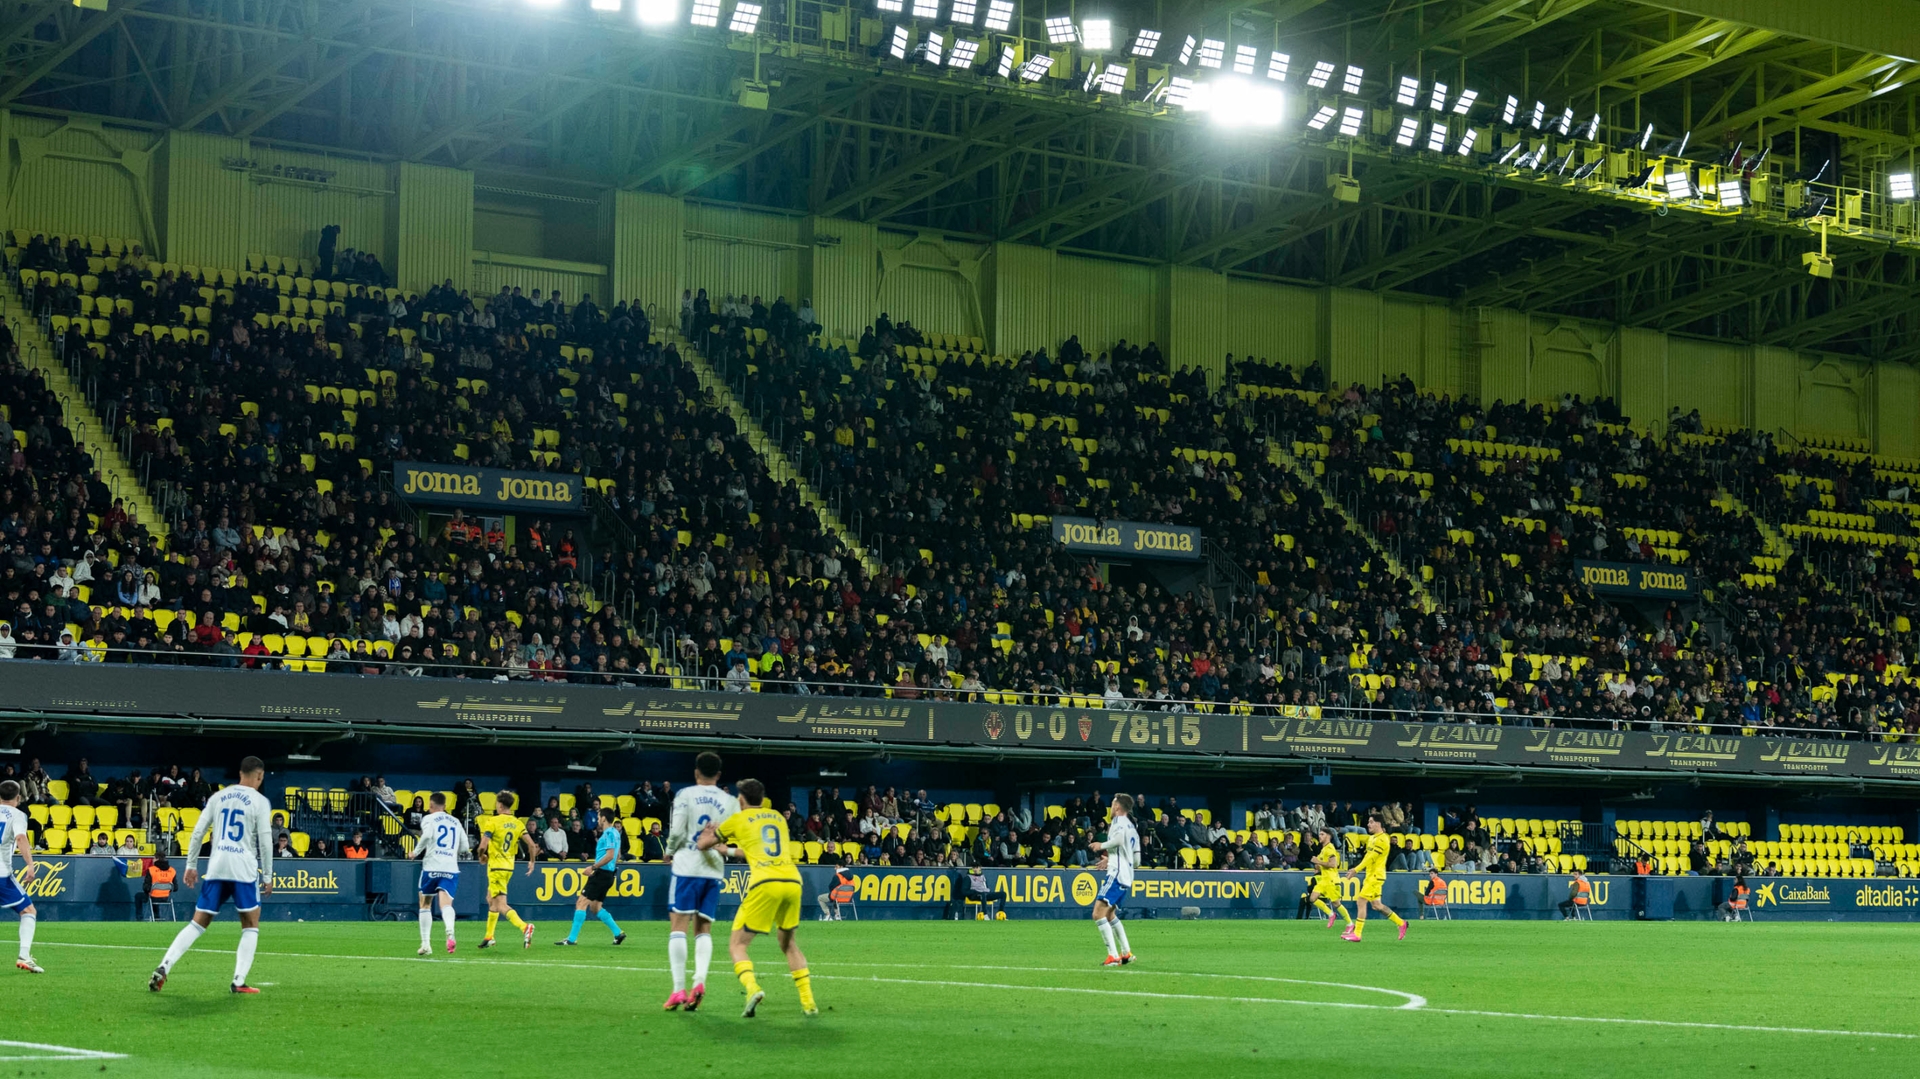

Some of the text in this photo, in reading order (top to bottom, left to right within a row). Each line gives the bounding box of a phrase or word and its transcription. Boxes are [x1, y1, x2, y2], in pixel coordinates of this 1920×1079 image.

[456, 713, 532, 722] TRANSPORTES
[639, 720, 711, 729] TRANSPORTES
[811, 727, 878, 735] TRANSPORTES
[1109, 713, 1201, 746] 78:15
[1290, 745, 1346, 753] TRANSPORTES
[1424, 750, 1476, 758] TRANSPORTES
[221, 808, 245, 842] 15
[436, 825, 457, 850] 21
[503, 831, 514, 853] 8
[762, 824, 781, 857] 9
[259, 869, 338, 889] ixaBank
[1779, 885, 1831, 900] CaixaBank
[1856, 884, 1903, 907] altadia
